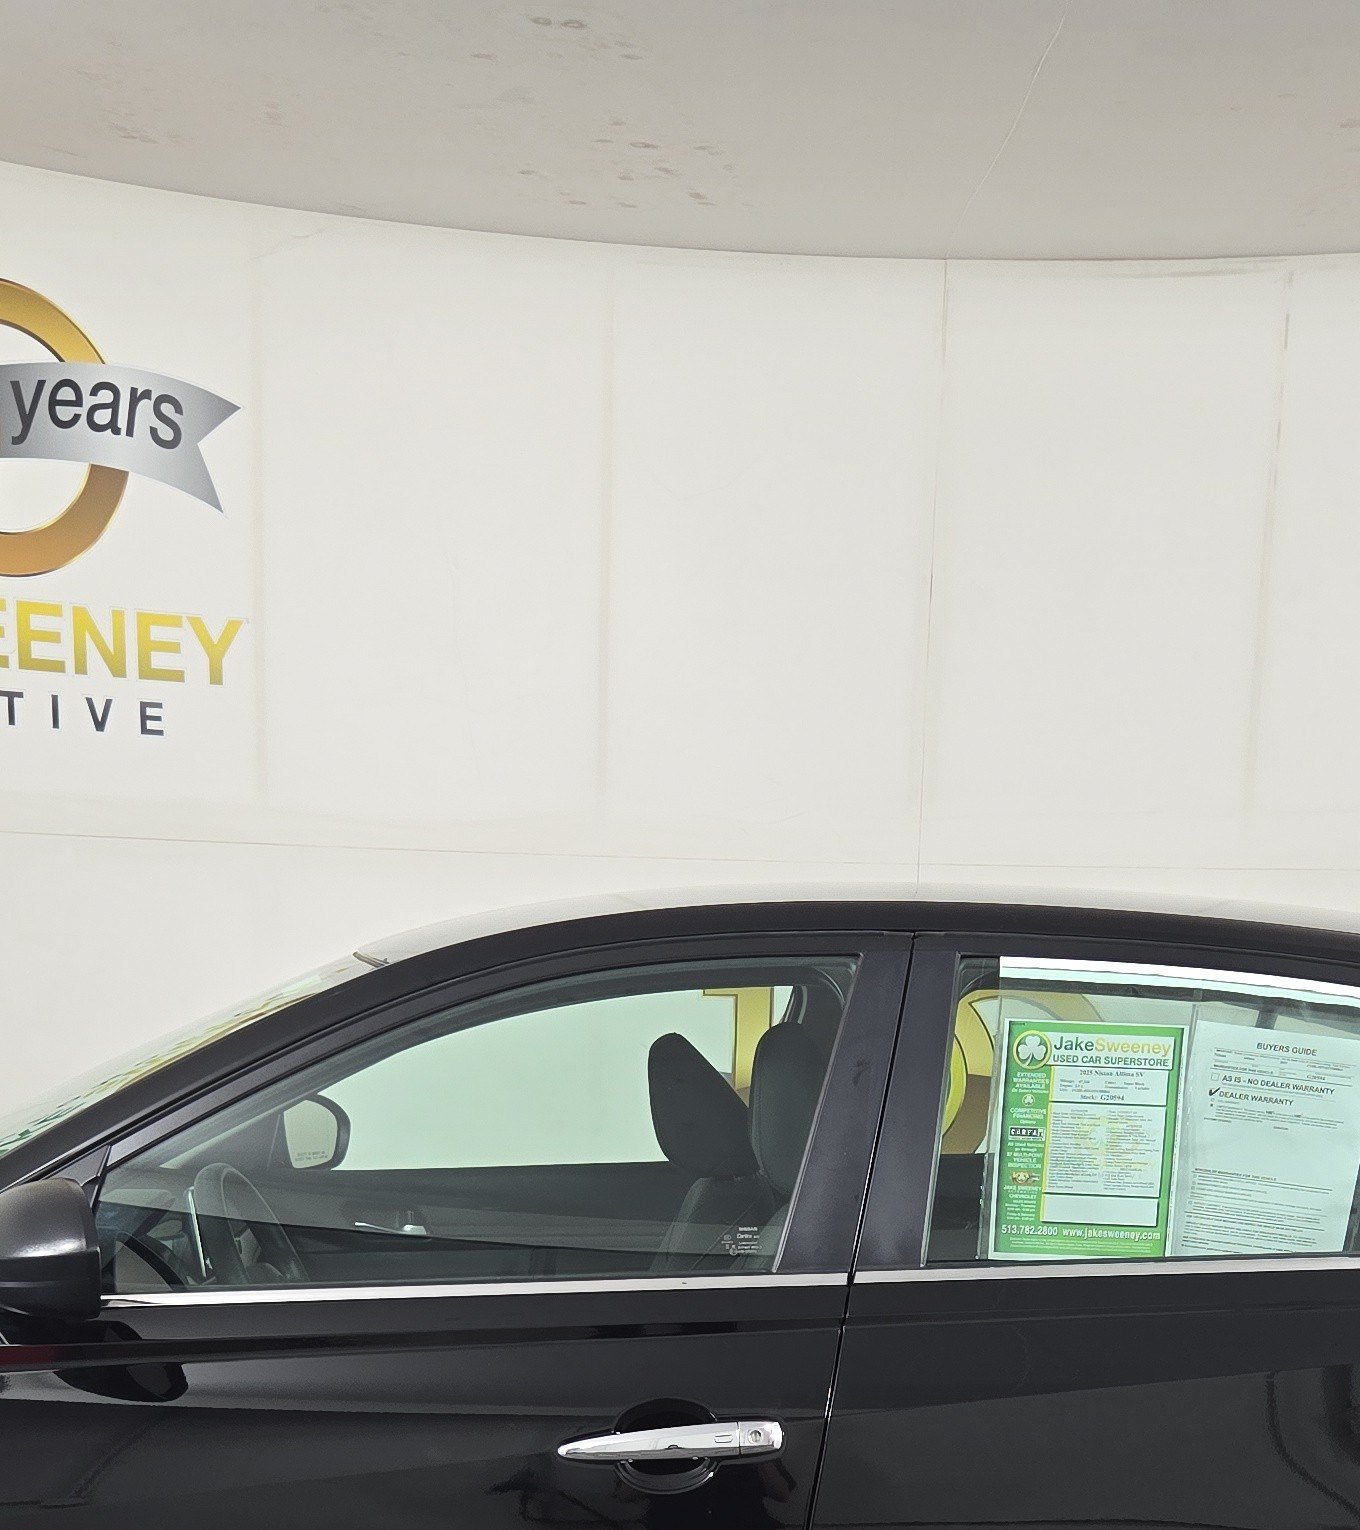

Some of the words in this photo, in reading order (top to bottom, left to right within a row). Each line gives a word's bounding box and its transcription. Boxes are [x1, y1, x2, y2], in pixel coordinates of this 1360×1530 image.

[10, 376, 185, 450] years
[1256, 1042, 1290, 1053] BUYERS
[1291, 1047, 1318, 1056] GUIDE
[1052, 1054, 1079, 1063] USED
[1081, 1055, 1102, 1064] CAR
[1104, 1056, 1170, 1067] SUPERSTORE
[1222, 1074, 1233, 1082] AS
[1260, 1080, 1291, 1090] DEALER
[1292, 1083, 1336, 1095] WARRANTY
[1219, 1090, 1250, 1101] DEALER
[1251, 1093, 1294, 1106] WARRANTY
